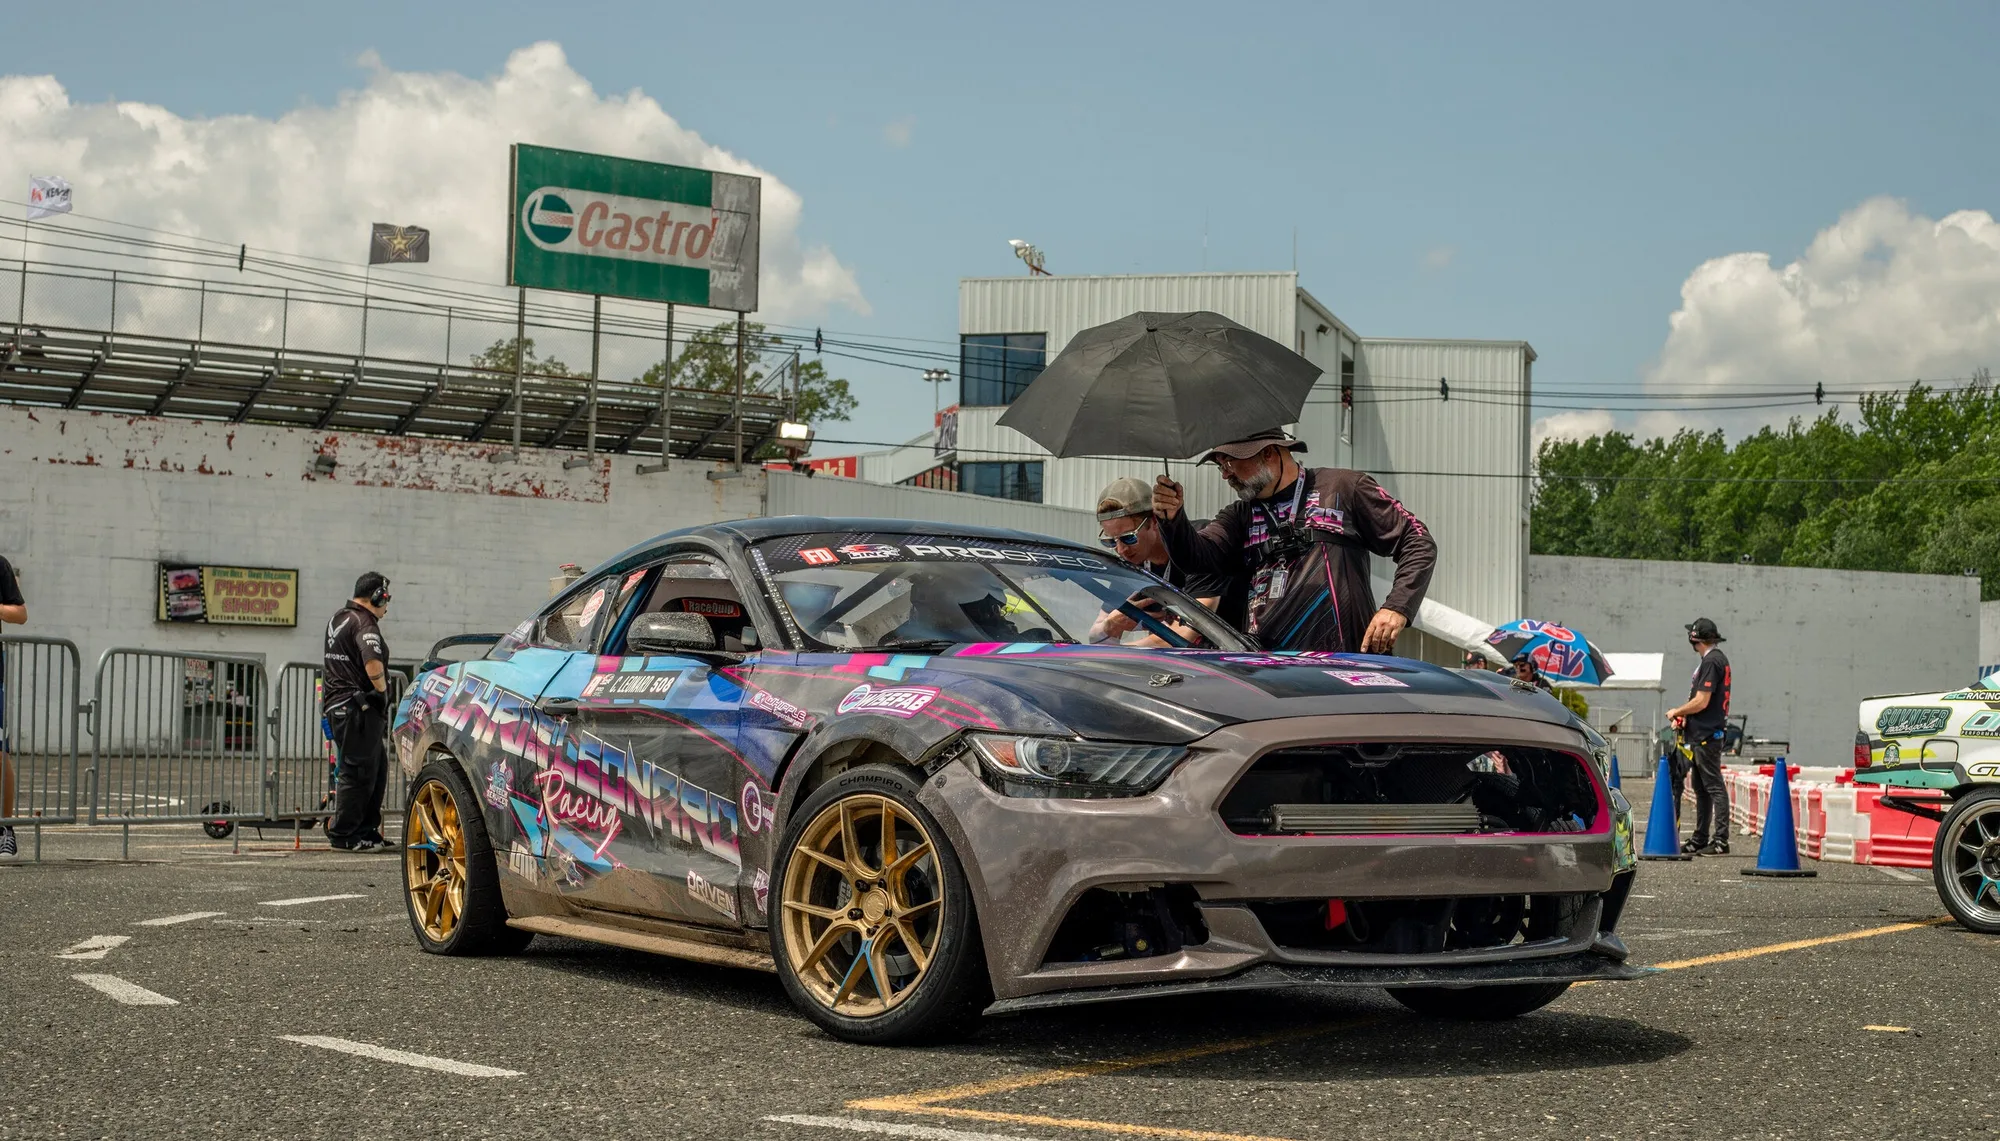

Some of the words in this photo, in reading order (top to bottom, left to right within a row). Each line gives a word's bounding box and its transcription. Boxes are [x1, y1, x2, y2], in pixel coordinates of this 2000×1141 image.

[577, 201, 717, 261] Castro
[905, 544, 1108, 571] PROSPEC
[214, 580, 289, 598] PHOTO
[222, 597, 279, 614] SHOP
[689, 601, 734, 614] RaceQuip
[617, 676, 655, 693] LEONARD
[650, 677, 675, 692] 508
[860, 692, 933, 711] WISEFAB
[1966, 692, 2000, 701] RACING
[764, 695, 807, 722] WHIPPLE
[839, 775, 903, 791] CHAMPIRO
[553, 718, 742, 869] LEONARD
[534, 764, 622, 858] Racing
[687, 870, 735, 915] DRIVEN
